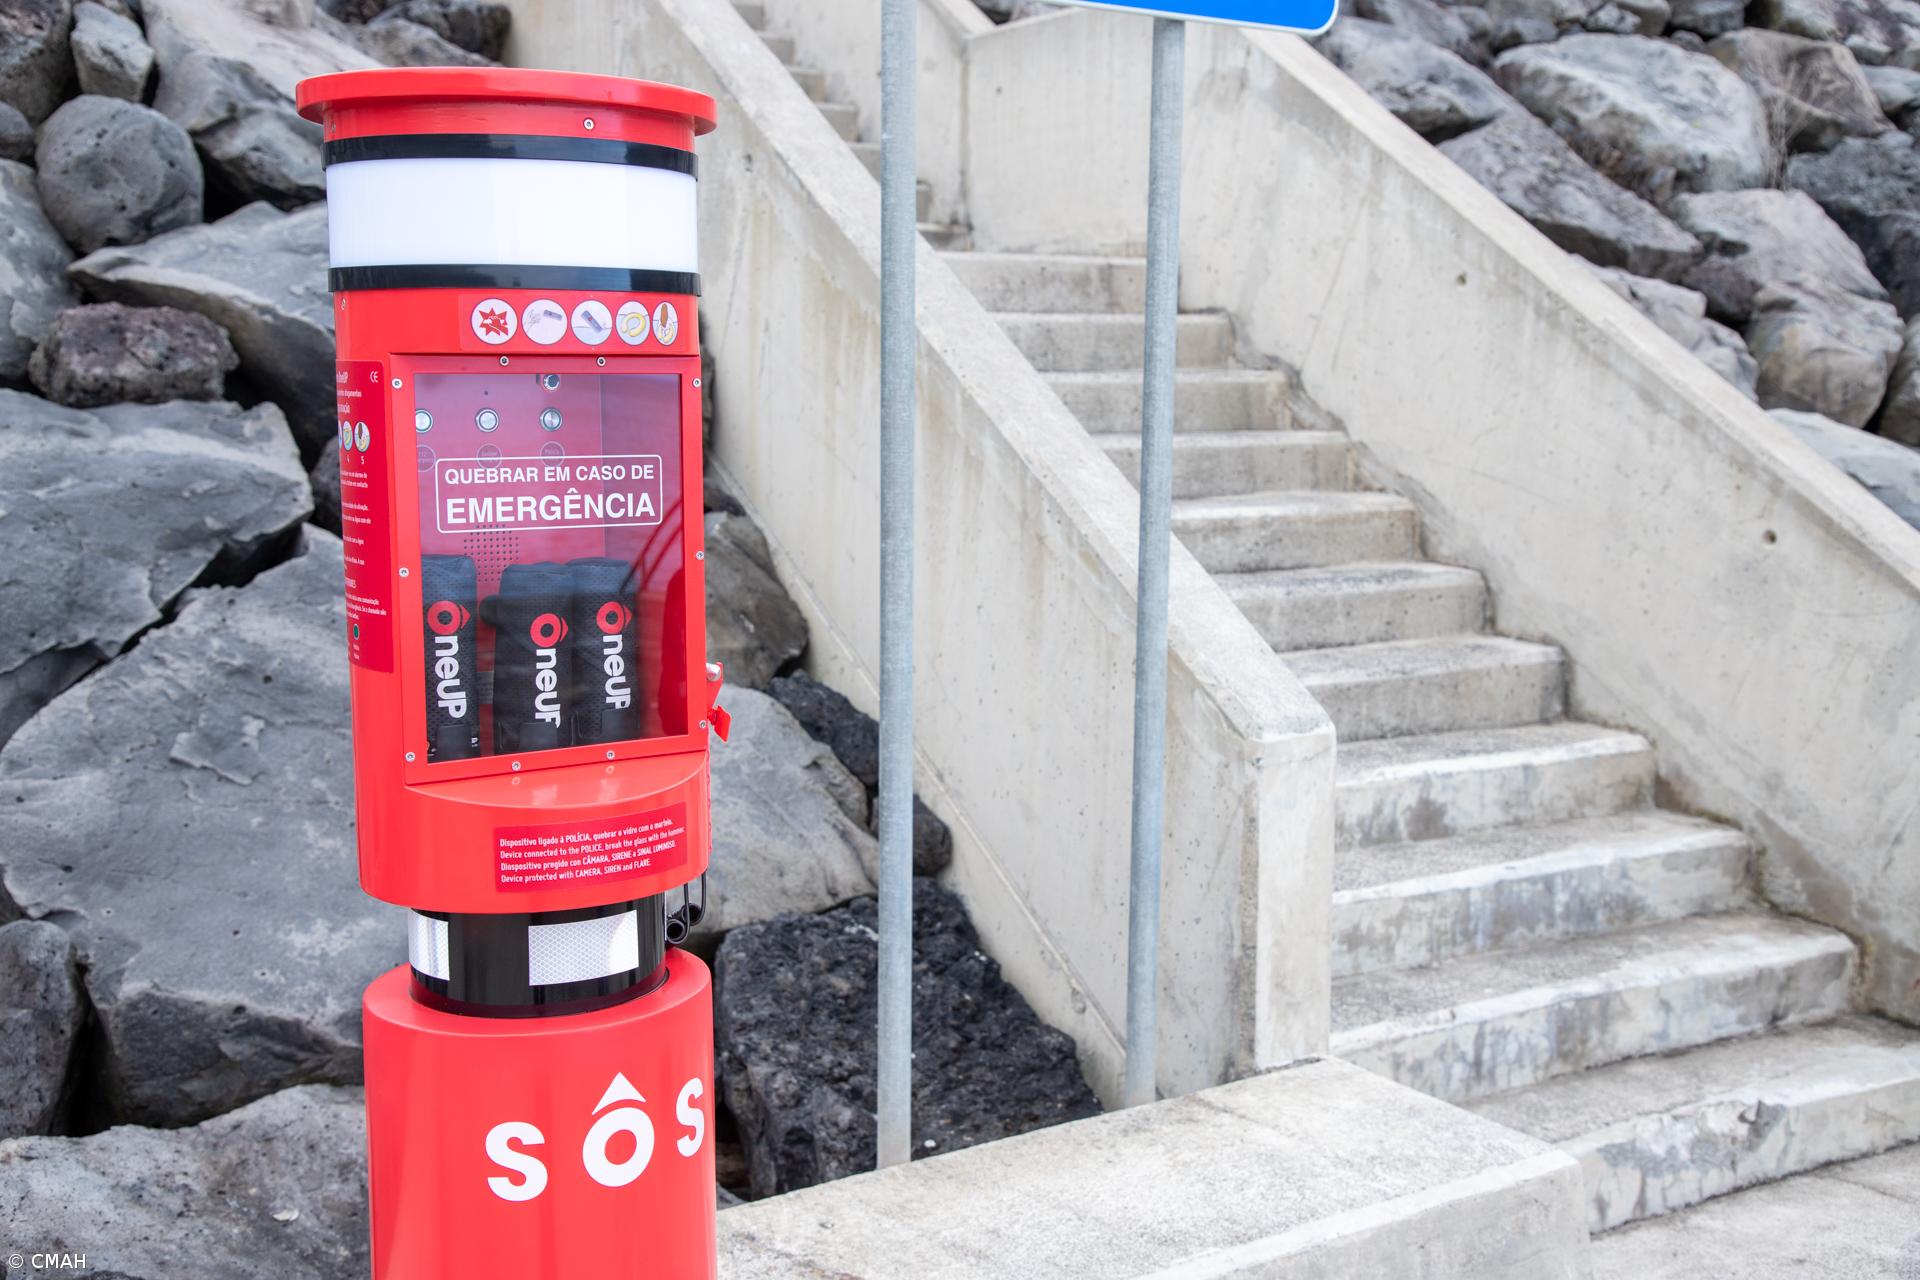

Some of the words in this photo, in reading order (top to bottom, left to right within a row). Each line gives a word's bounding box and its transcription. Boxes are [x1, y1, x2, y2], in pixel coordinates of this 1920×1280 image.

[360, 456, 365, 464] 5
[444, 467, 538, 485] QUEBRAR
[544, 466, 570, 482] EM
[576, 465, 626, 480] CASO
[632, 464, 654, 480] DE
[446, 488, 656, 524] EMERGÊNCIA
[500, 838, 536, 848] Dispositivo
[538, 836, 558, 846] ligado
[593, 830, 616, 841] quebrar
[622, 828, 638, 836] vidro
[638, 824, 650, 832] com
[500, 850, 522, 858] Device
[524, 848, 558, 858] connected
[560, 848, 566, 856] to
[568, 846, 580, 854] the
[605, 840, 622, 850] break
[623, 839, 633, 848] the
[634, 837, 647, 847] glass
[648, 834, 660, 842] with
[660, 831, 668, 839] the
[543, 860, 568, 870] pregido
[612, 850, 632, 861] SIRENE
[637, 846, 652, 856] SINAL
[502, 874, 524, 882] Device
[524, 872, 557, 884] protected
[558, 871, 574, 880] with
[604, 864, 622, 874] SIREN
[622, 862, 633, 870] and
